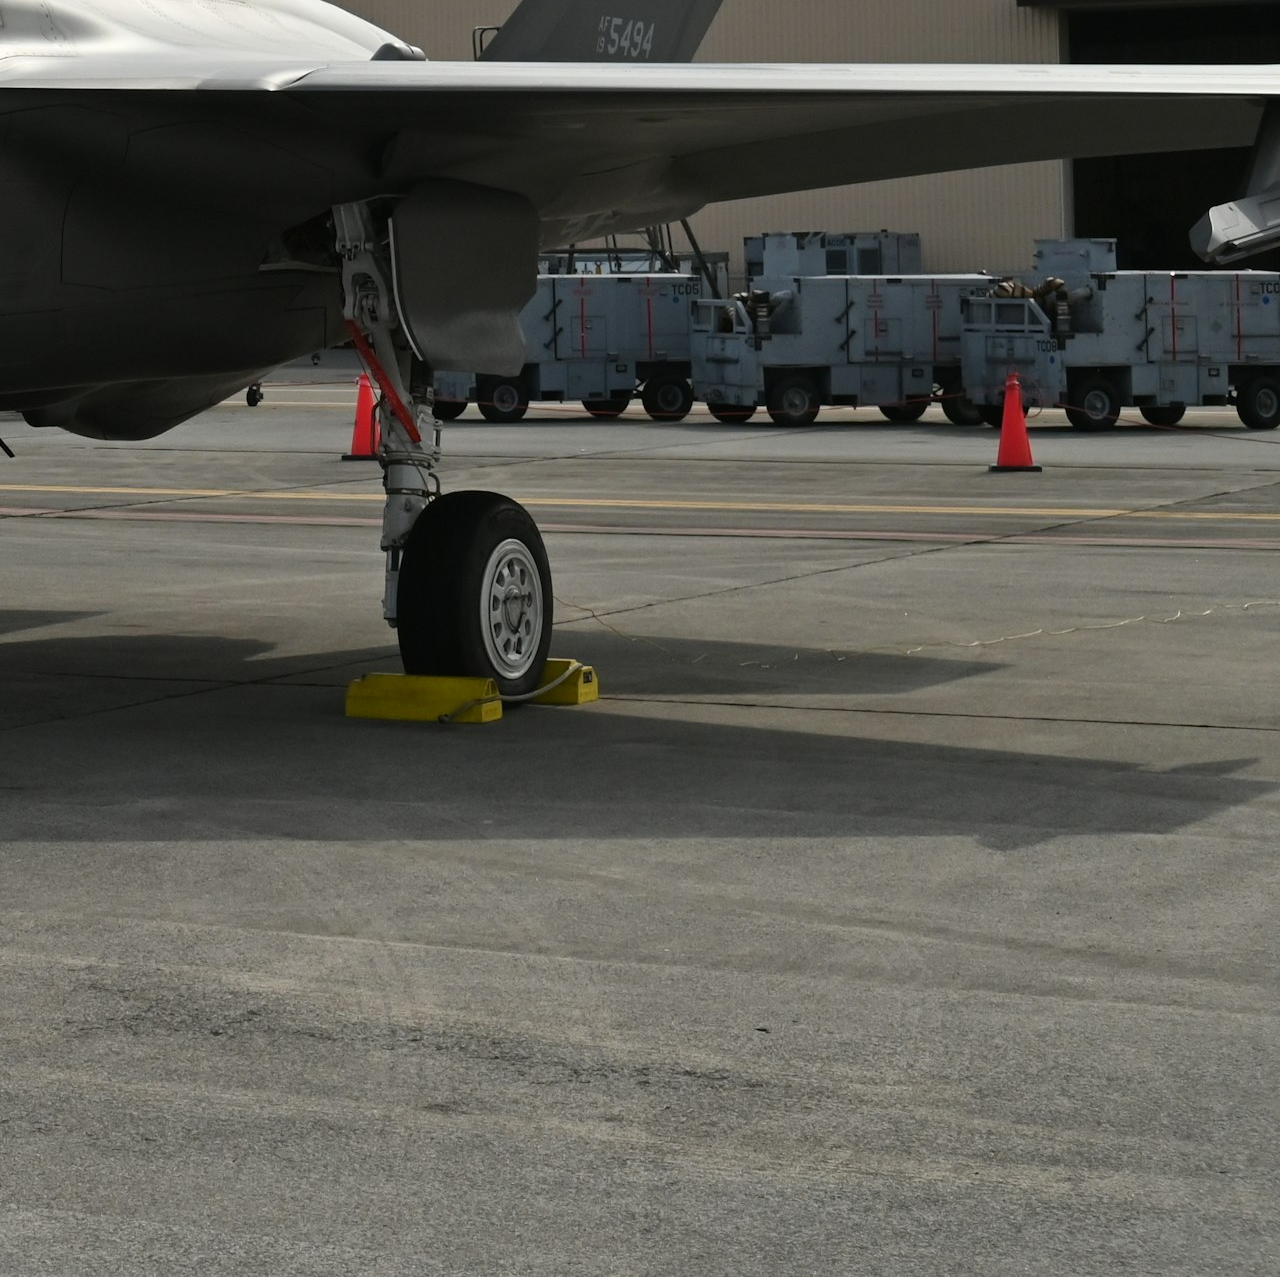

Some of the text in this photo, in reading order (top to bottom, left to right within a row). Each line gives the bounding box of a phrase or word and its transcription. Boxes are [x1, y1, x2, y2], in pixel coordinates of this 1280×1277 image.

[598, 16, 611, 32] AF
[596, 36, 605, 53] 19
[607, 17, 655, 59] 5494
